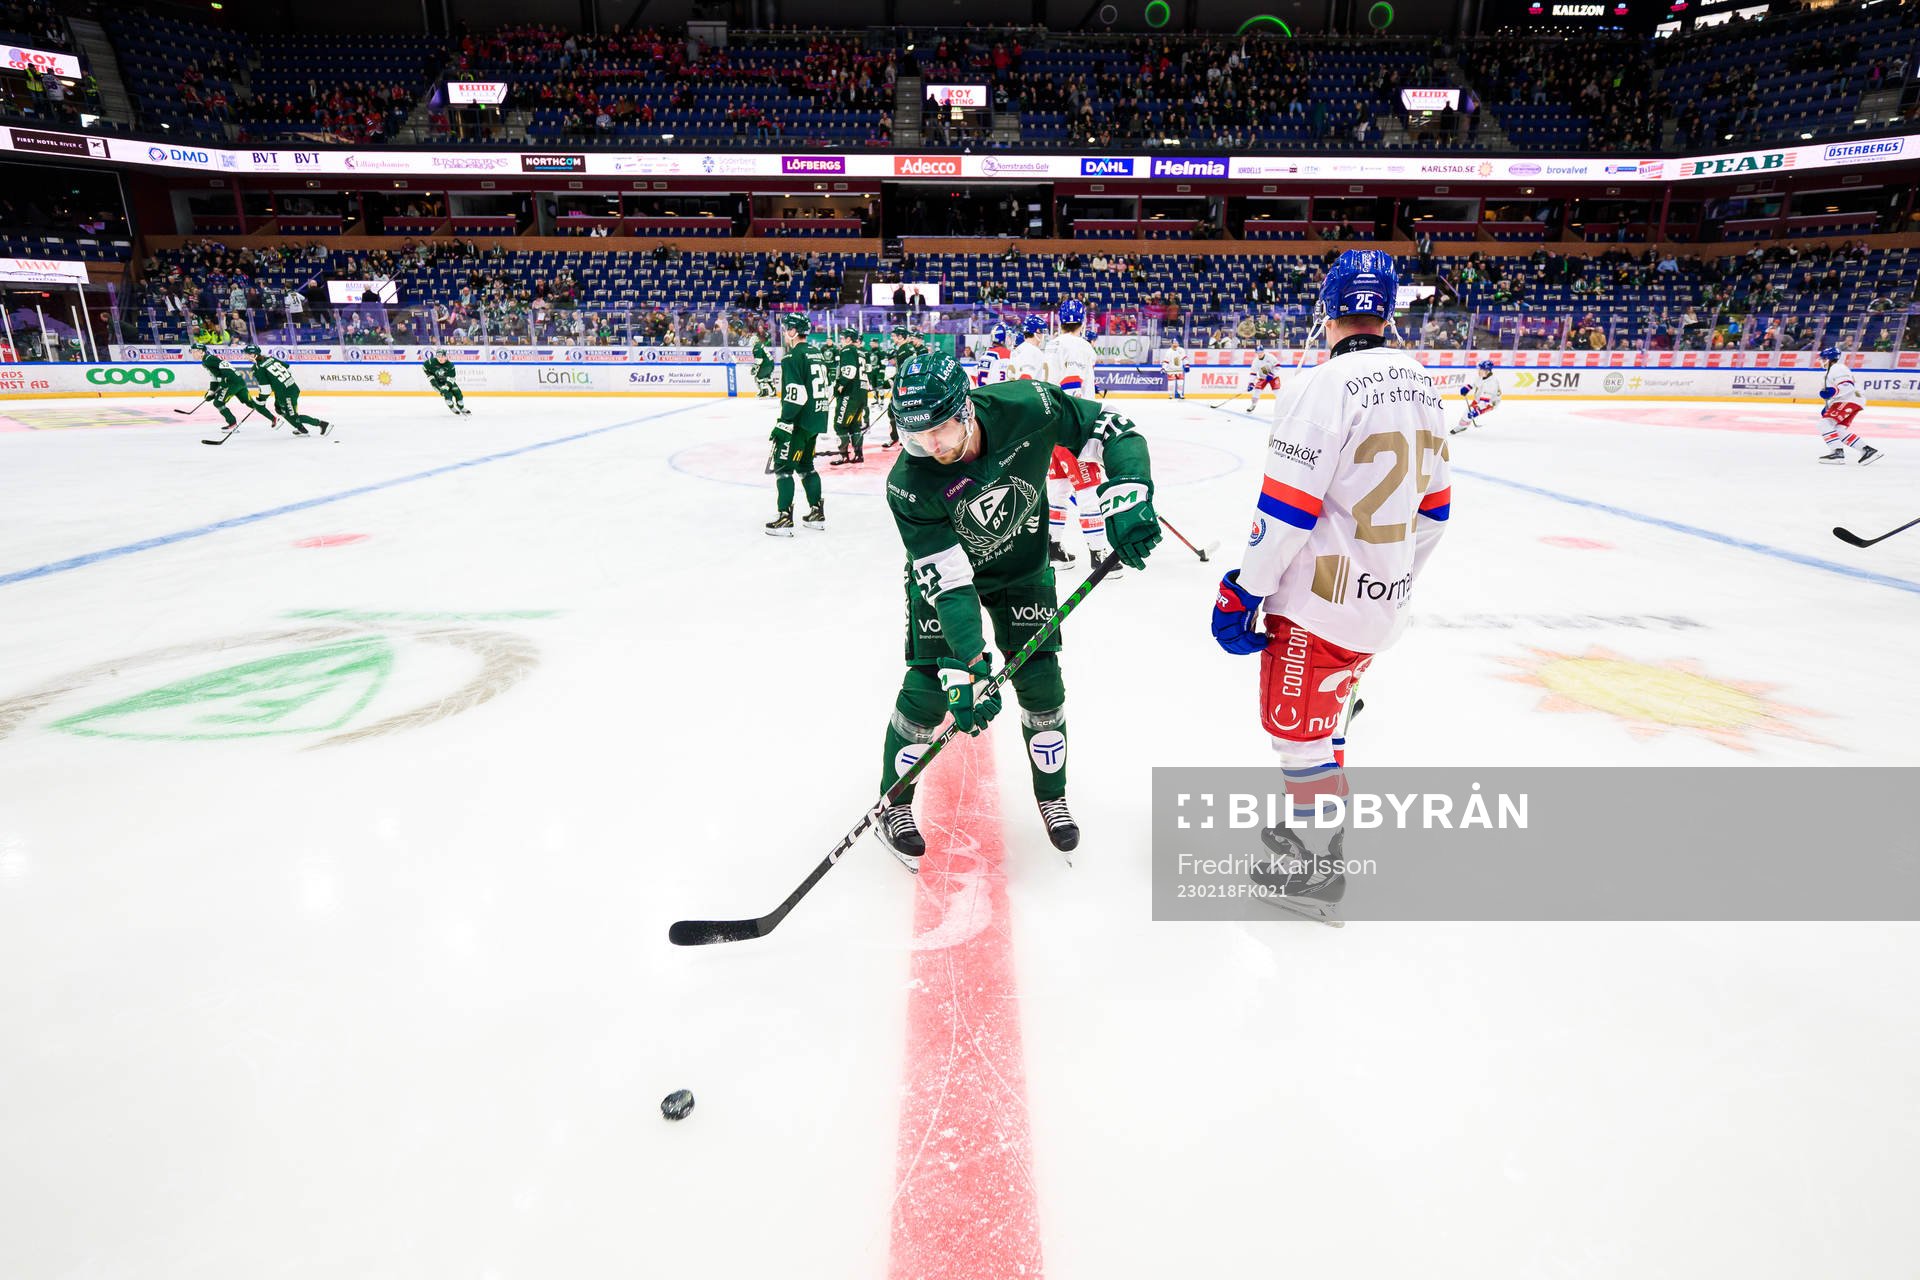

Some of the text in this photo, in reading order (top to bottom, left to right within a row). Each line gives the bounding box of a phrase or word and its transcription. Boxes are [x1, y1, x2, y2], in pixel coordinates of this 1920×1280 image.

[1552, 5, 1605, 16] KALLZON
[20, 52, 57, 66] KOY
[8, 61, 65, 75] COTIG
[947, 89, 971, 98] KOY
[17, 136, 35, 144] FIRST
[1828, 141, 1900, 157] ÖSTERBERGS
[170, 149, 209, 163] DMD
[252, 152, 278, 163] BVT
[294, 152, 320, 163] BVT
[525, 156, 581, 166] NORTHCOM
[786, 158, 841, 171] LÖFBERGS
[901, 158, 956, 174] Adecco
[1086, 160, 1128, 173] DAHL
[1154, 160, 1226, 176] Helmia
[1421, 165, 1475, 174] KARLSTAD.SE
[1546, 165, 1589, 175] brovalvet
[1691, 153, 1785, 176] PEAB
[1355, 293, 1374, 310] 25
[86, 368, 175, 388] coop
[319, 374, 375, 383] KARLSTAD.SE
[628, 372, 665, 383] Salos
[1105, 372, 1164, 385] Matthiessen
[1346, 371, 1384, 396] Dina
[1431, 374, 1467, 386] IXFM
[1536, 372, 1581, 388] PSM
[30, 381, 49, 389] AB
[1863, 379, 1901, 391] PUTS
[901, 399, 923, 407] CCM
[903, 413, 931, 424] KEWAB
[1268, 434, 1319, 466] rmakök
[946, 477, 974, 498] LÖFBERG
[1100, 489, 1139, 516] CM
[919, 619, 941, 633] vo
[1036, 718, 1056, 727] CCM
[828, 795, 892, 866] CCM
